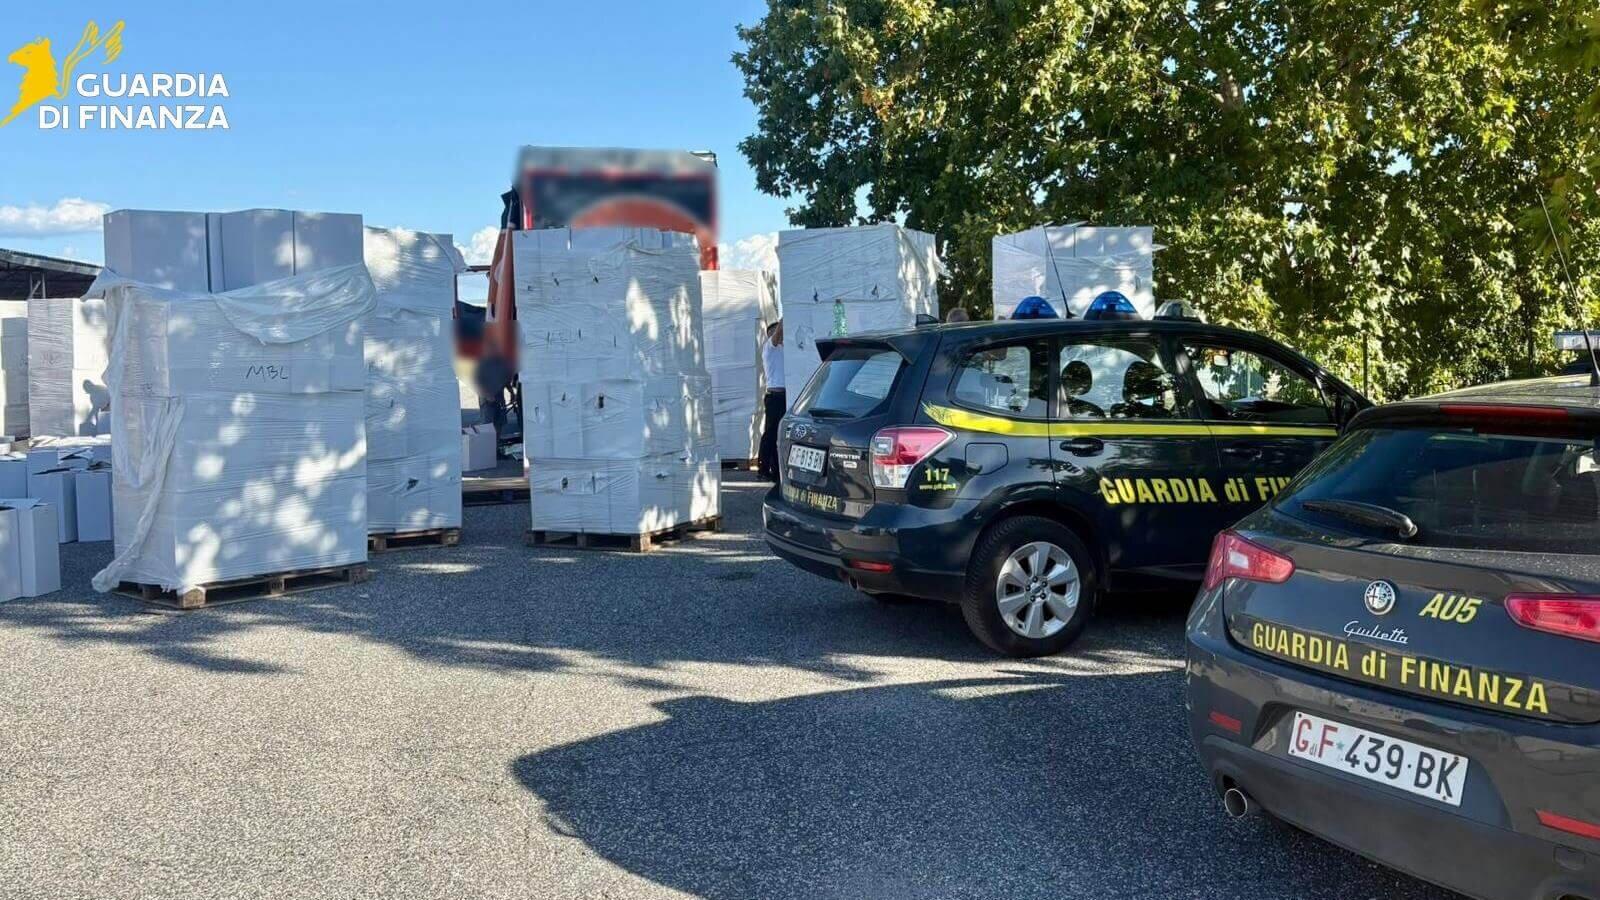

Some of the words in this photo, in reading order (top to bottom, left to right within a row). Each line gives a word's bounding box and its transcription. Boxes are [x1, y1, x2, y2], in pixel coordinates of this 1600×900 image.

[245, 365, 289, 382] MBL
[829, 452, 861, 461] FORESTER
[925, 468, 950, 482] 117
[1100, 477, 1217, 504] GUARDIA
[1224, 478, 1250, 502] di
[1418, 593, 1483, 624] AU5
[1343, 620, 1409, 645] Giulietta
[1252, 622, 1350, 671] GUARDIA
[1361, 651, 1387, 680] di
[1400, 656, 1549, 714] FINANZA
